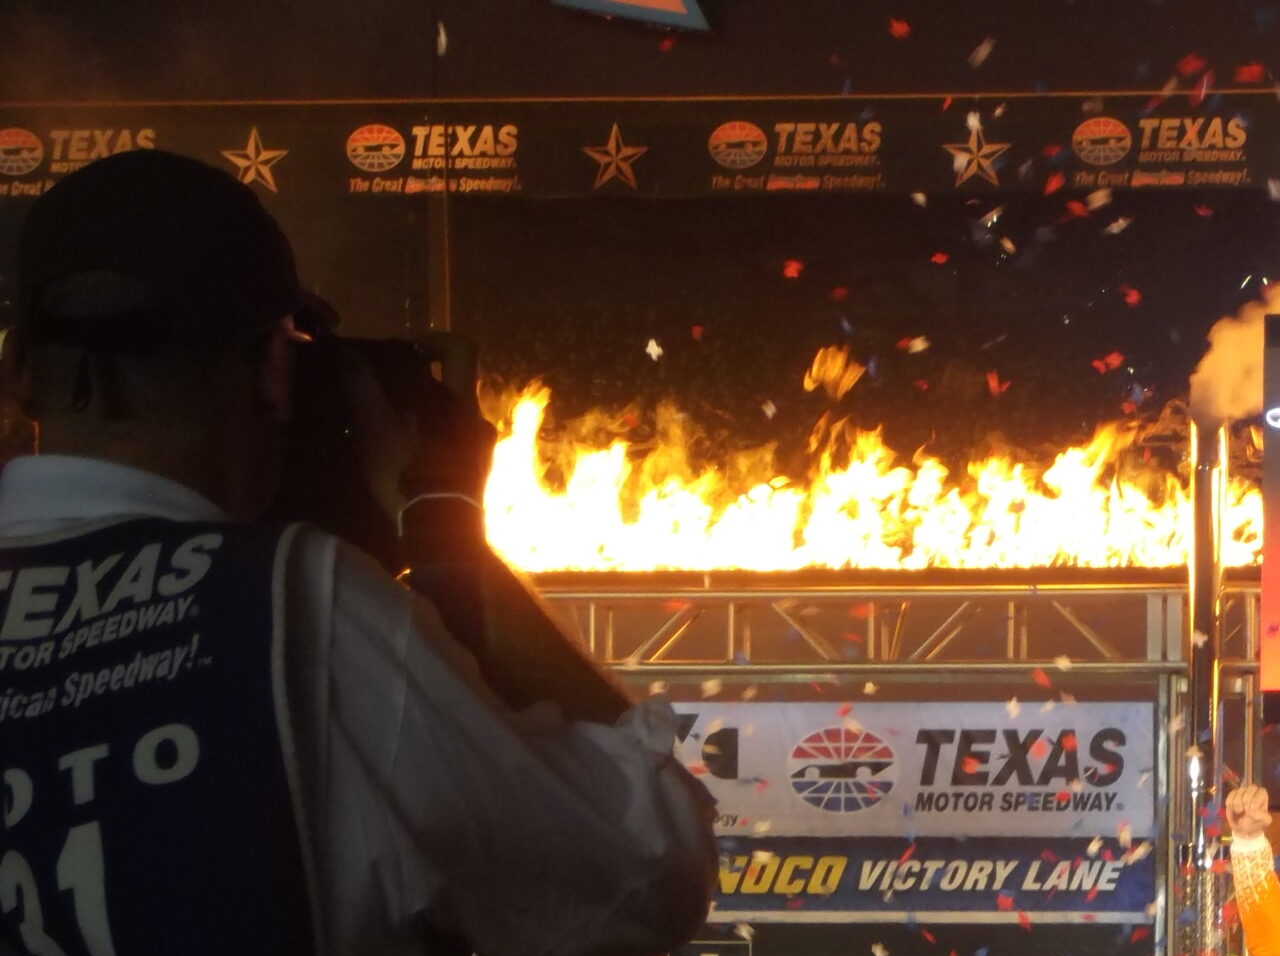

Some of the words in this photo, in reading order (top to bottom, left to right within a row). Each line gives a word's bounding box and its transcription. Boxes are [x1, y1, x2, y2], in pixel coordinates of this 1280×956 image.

[50, 129, 156, 160] TEXAS
[411, 123, 518, 157] TEXAS
[774, 121, 882, 153] TEXAS
[1138, 117, 1247, 149] TEXAS
[915, 728, 1127, 786] TEXAS
[915, 792, 994, 812] MOTOR
[858, 860, 1011, 892] VICTORY
[1021, 859, 1126, 892] LANE
